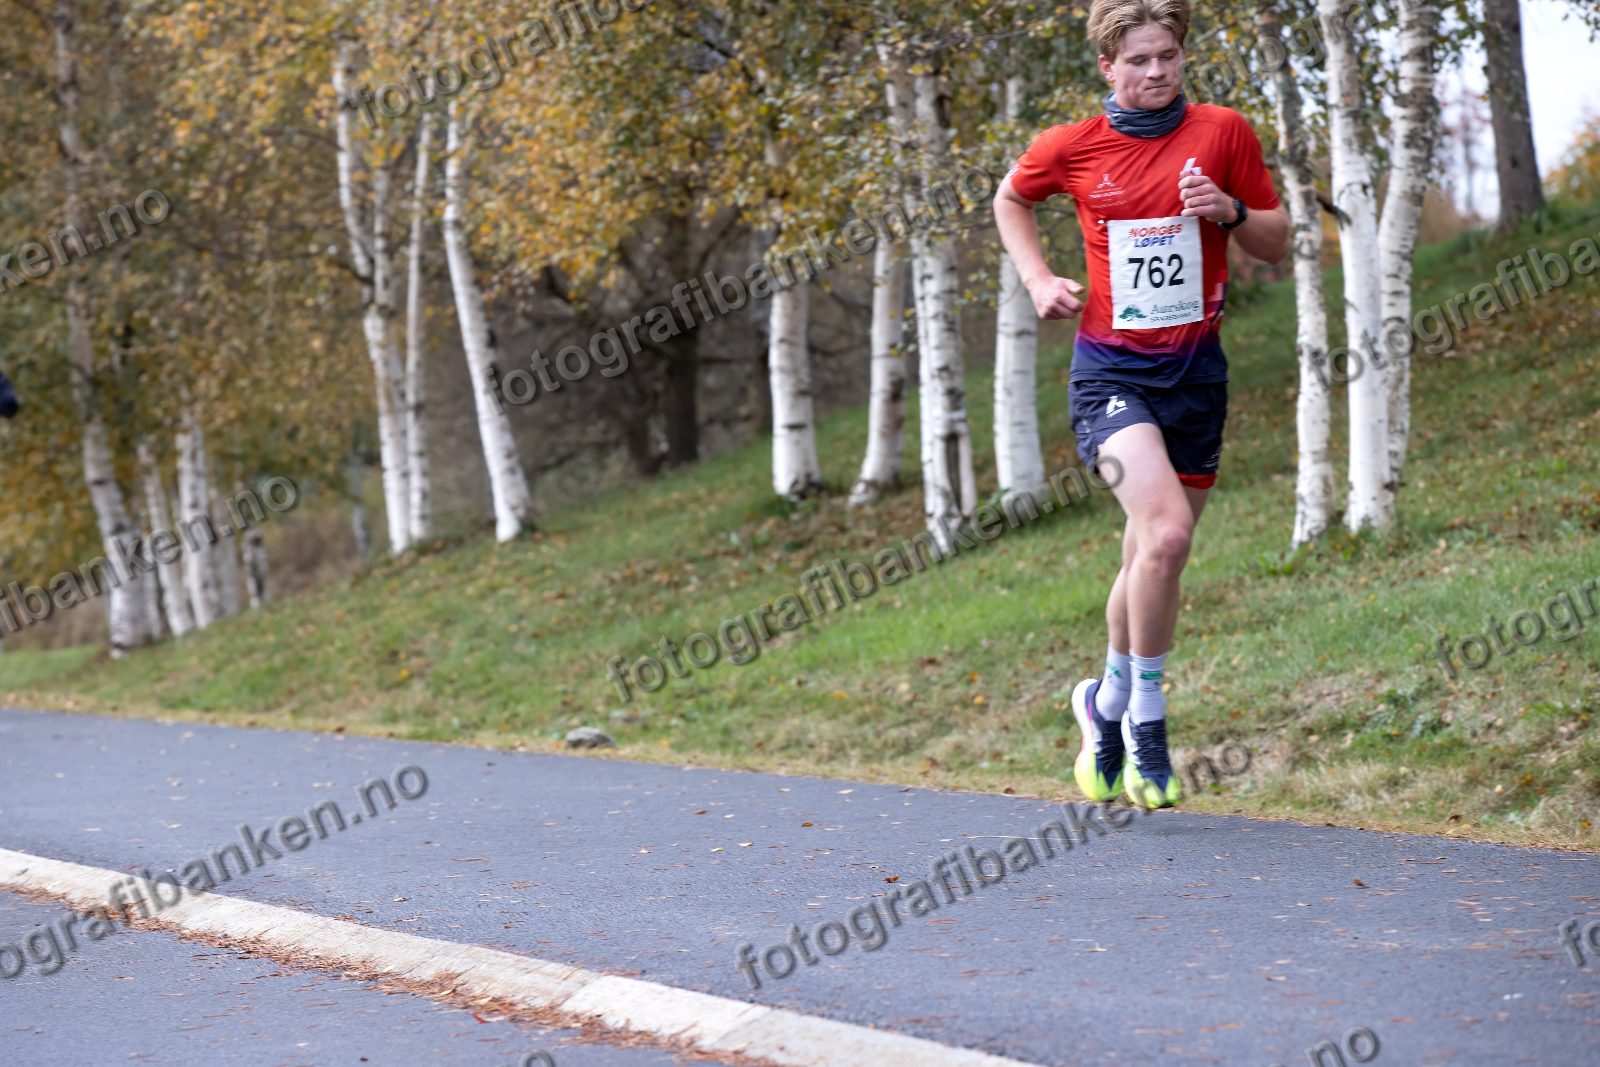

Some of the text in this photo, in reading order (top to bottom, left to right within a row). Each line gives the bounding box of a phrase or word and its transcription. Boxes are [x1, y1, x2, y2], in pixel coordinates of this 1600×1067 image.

[1129, 223, 1182, 238] NORGES
[1134, 235, 1175, 248] LØPET
[1128, 253, 1184, 289] 762
